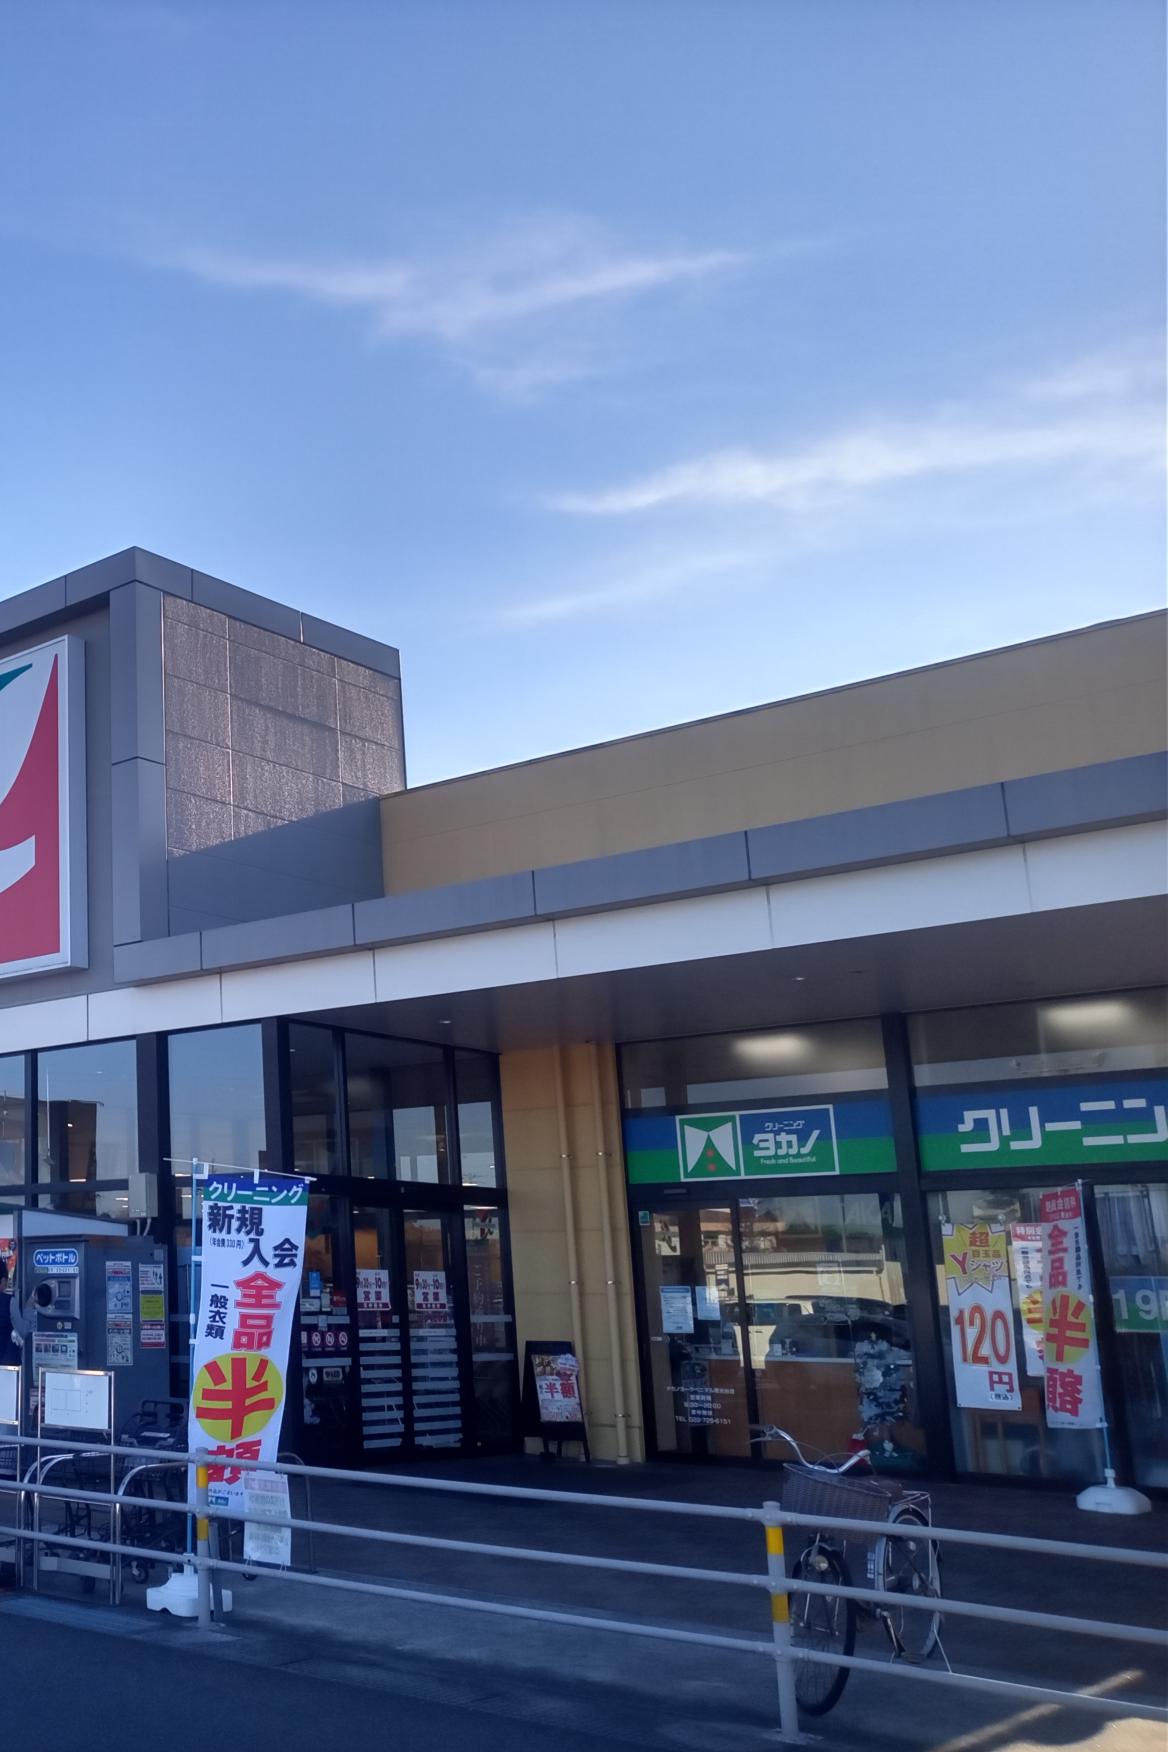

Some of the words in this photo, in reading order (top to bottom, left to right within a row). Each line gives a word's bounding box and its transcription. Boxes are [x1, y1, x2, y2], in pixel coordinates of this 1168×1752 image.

[764, 1120, 805, 1131] クリーニング
[752, 1130, 821, 1157] タカノ
[209, 1180, 304, 1204] クリーニング
[208, 1203, 264, 1236] 新規
[36, 1253, 76, 1264] ペットボトル
[242, 1238, 299, 1269] 入会
[205, 1283, 229, 1340] 一般衣類
[231, 1271, 285, 1351] 全品
[954, 1304, 1011, 1366] 120
[988, 1371, 1015, 1393] 円
